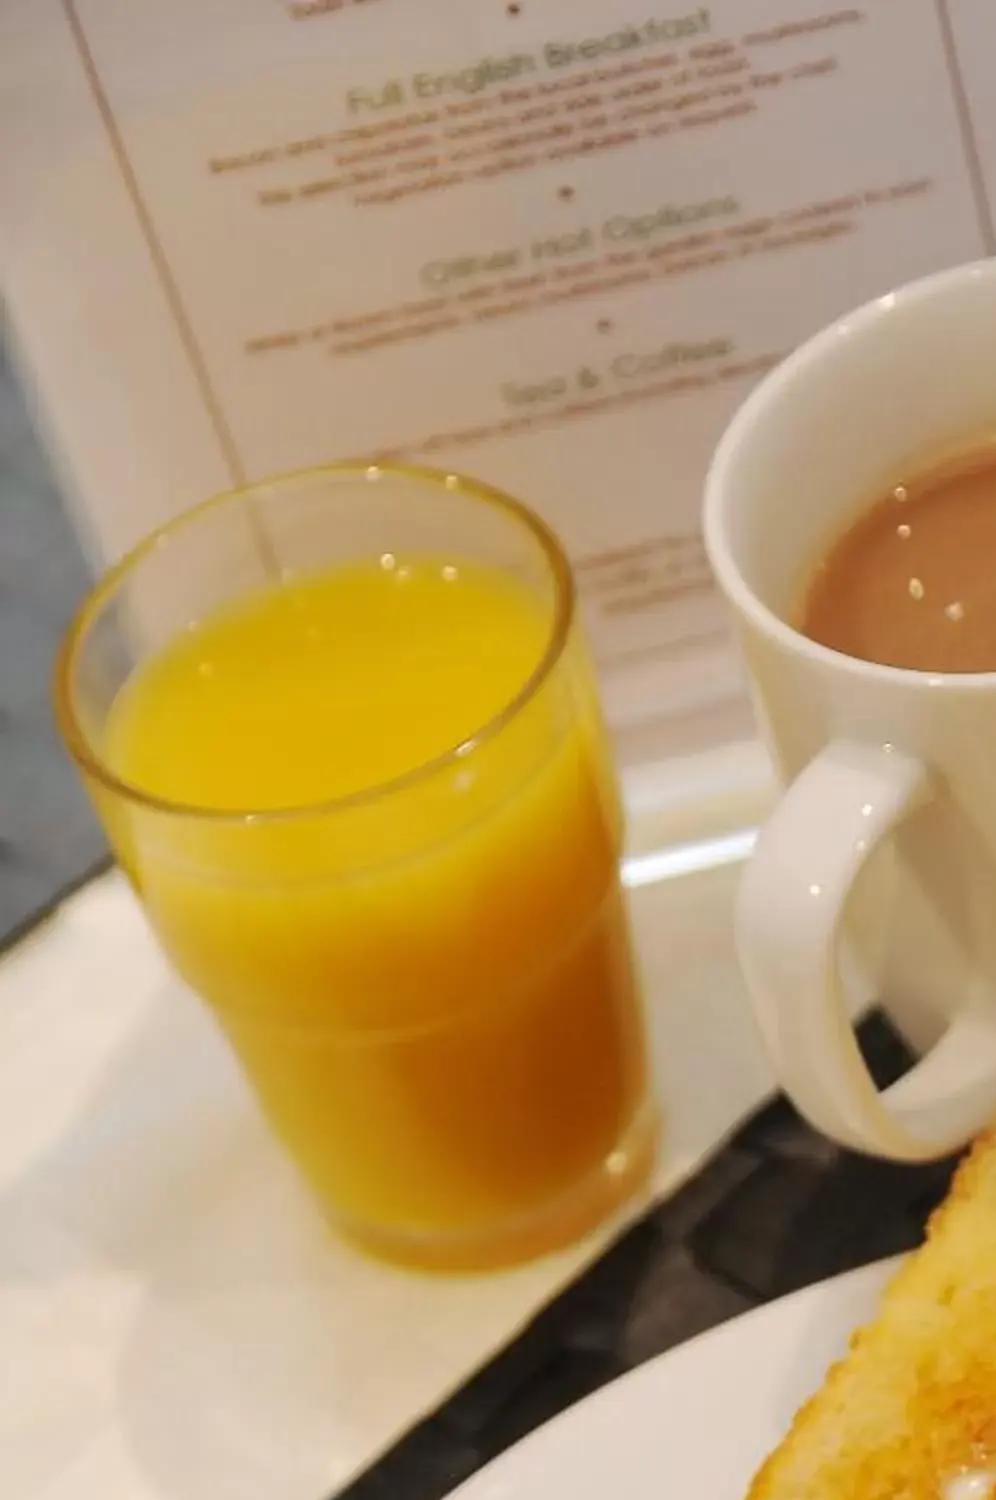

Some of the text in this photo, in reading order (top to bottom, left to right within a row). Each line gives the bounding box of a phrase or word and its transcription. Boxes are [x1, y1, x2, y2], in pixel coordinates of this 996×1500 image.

[346, 77, 403, 113] Full
[412, 54, 535, 98] English
[543, 10, 710, 69] Breakfast
[418, 250, 519, 285] Other
[603, 197, 739, 239] Options
[611, 336, 735, 376] Coffee
